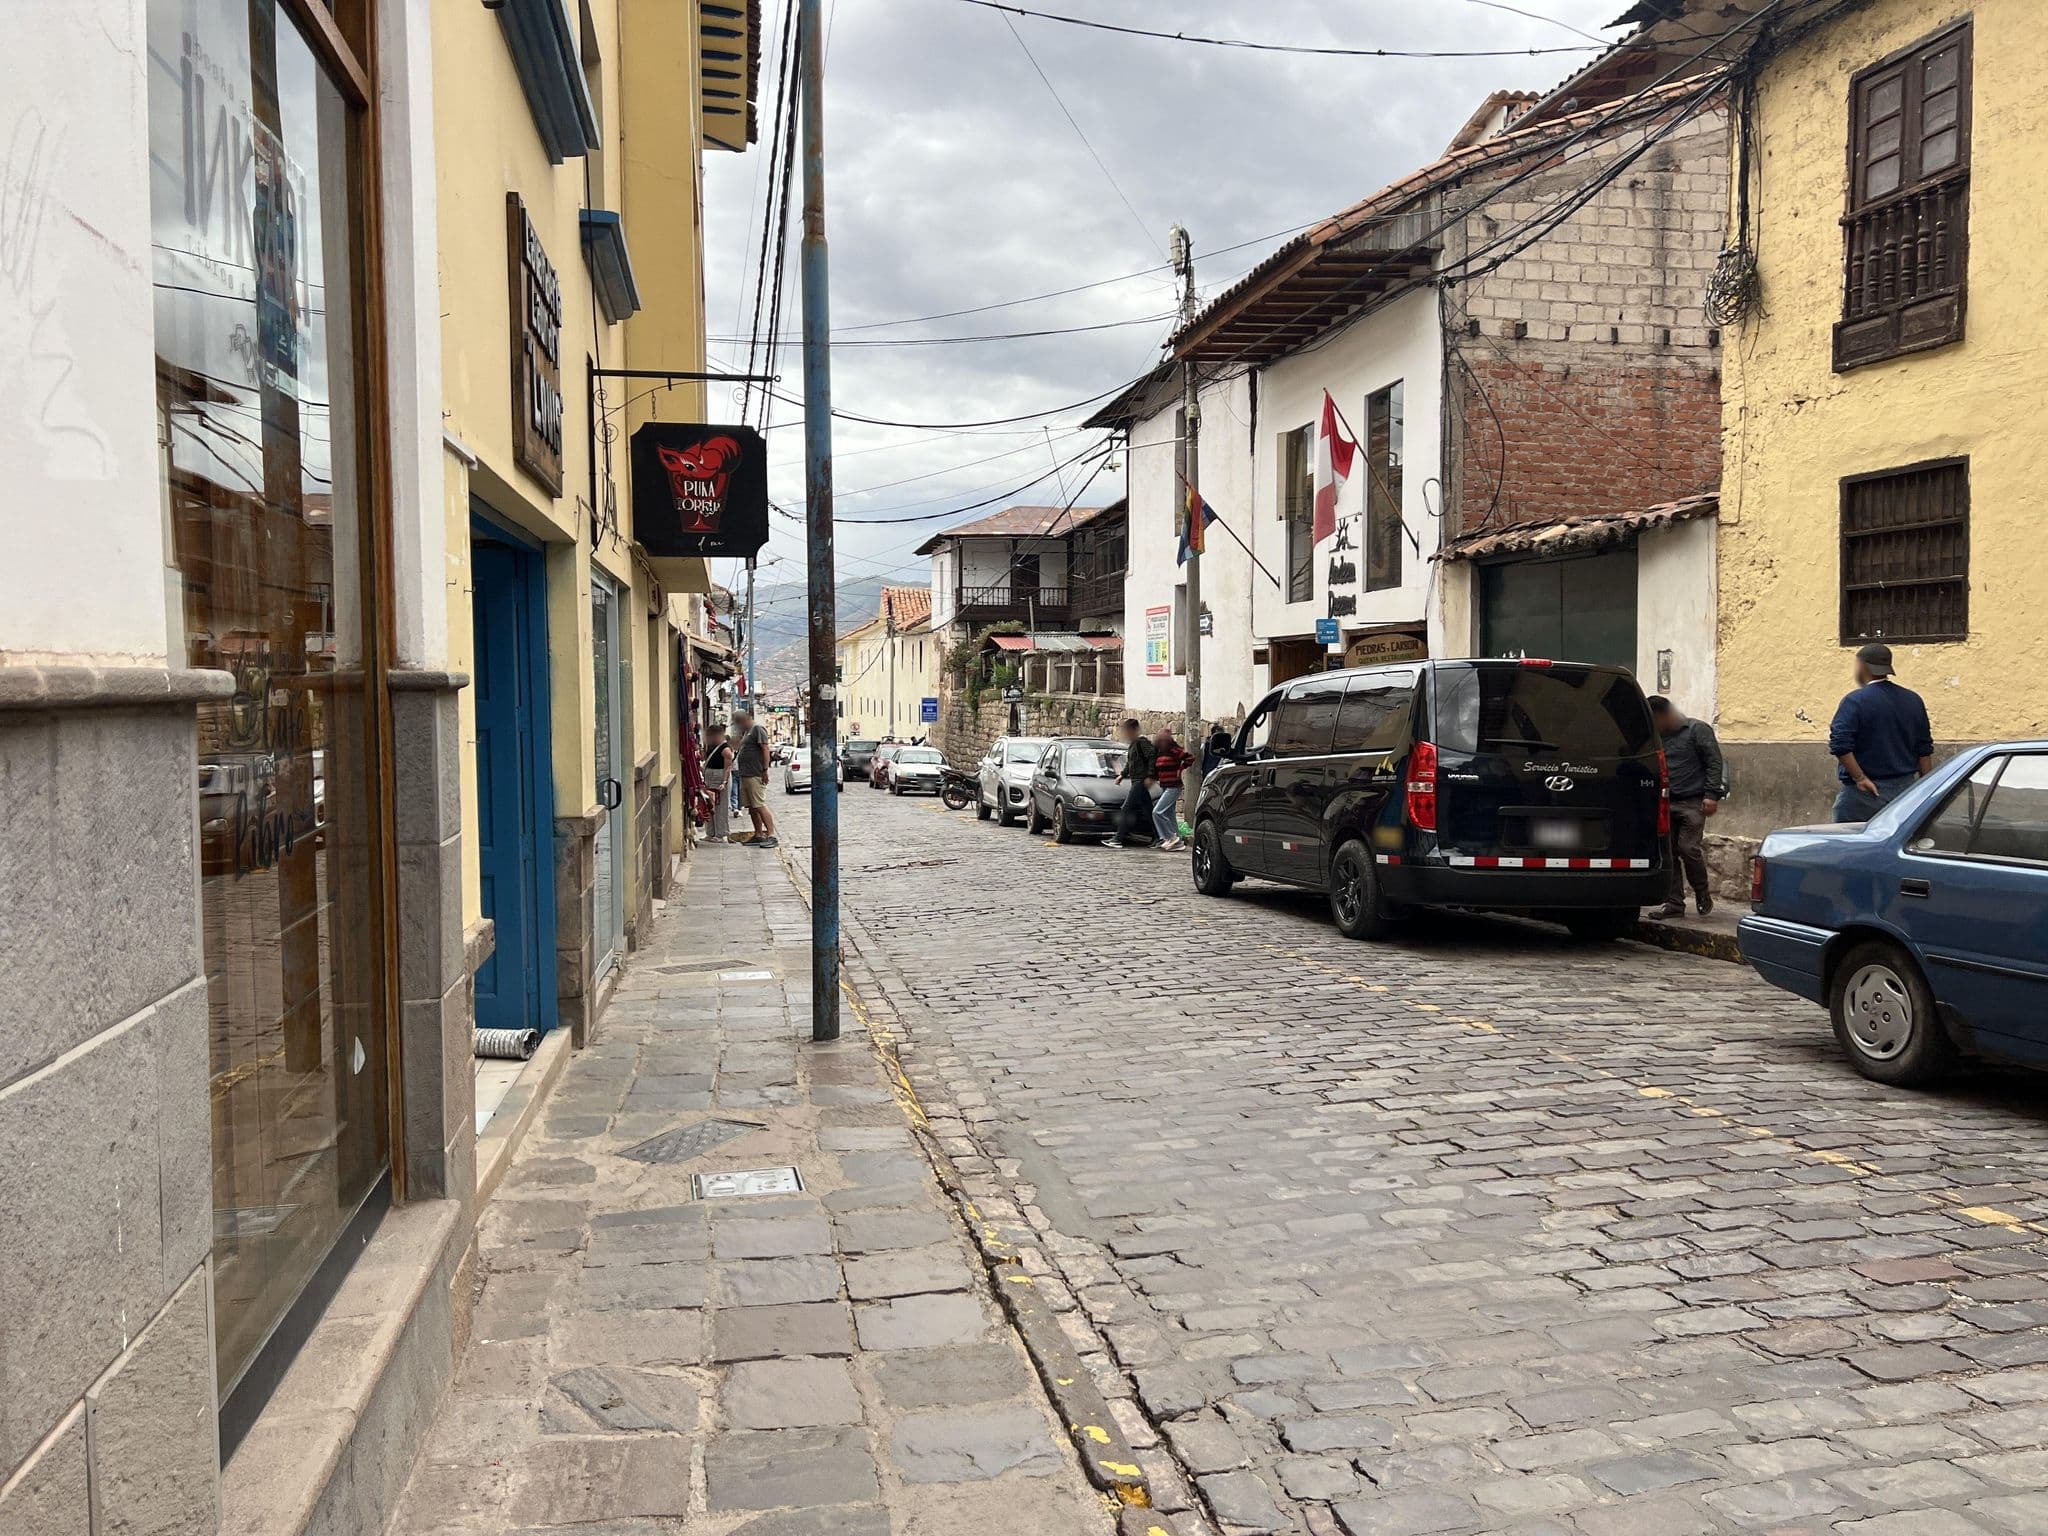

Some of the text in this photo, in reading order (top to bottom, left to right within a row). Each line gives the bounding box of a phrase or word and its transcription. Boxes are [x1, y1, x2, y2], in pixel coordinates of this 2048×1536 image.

[683, 480, 715, 497] PUMA
[1355, 643, 1386, 656] PIEDRAS
[1522, 761, 1559, 772] Servicio
